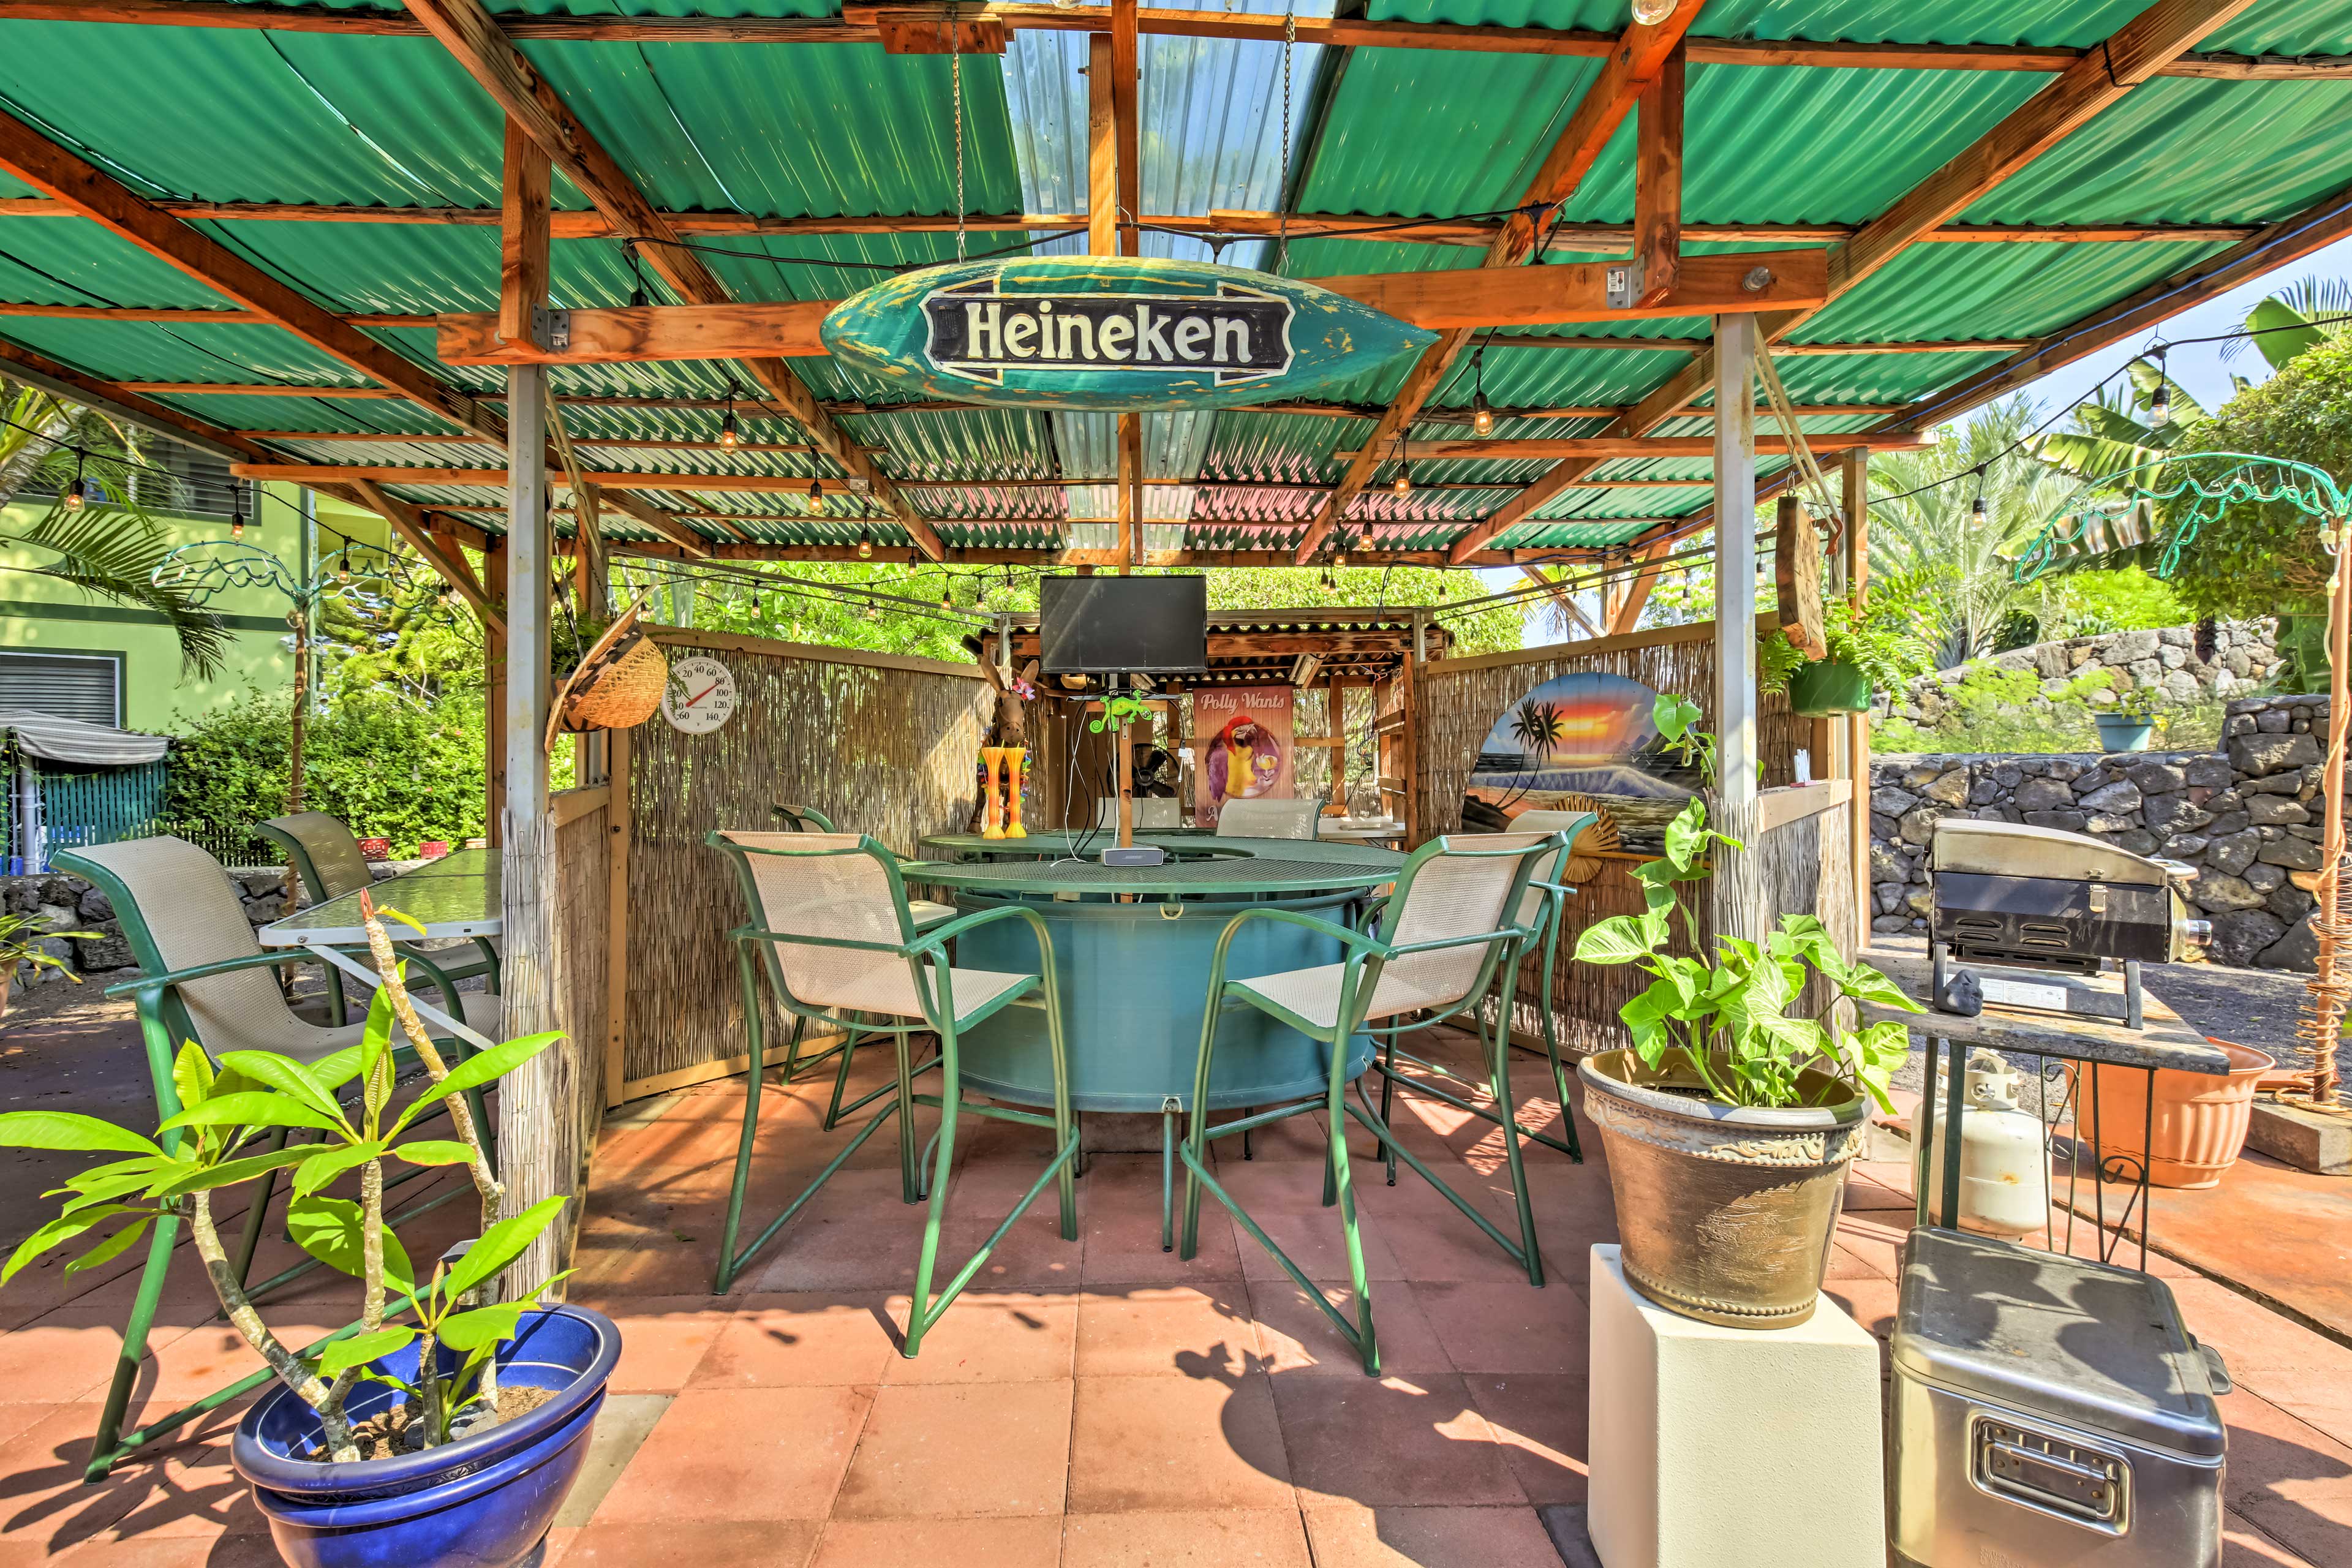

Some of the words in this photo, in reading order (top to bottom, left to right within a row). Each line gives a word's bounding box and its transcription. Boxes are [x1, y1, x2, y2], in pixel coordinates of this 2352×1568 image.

[963, 301, 1254, 364] Heineken
[694, 665, 704, 674] 40
[1200, 693, 1239, 715] Polly
[1242, 692, 1285, 709] Wants
